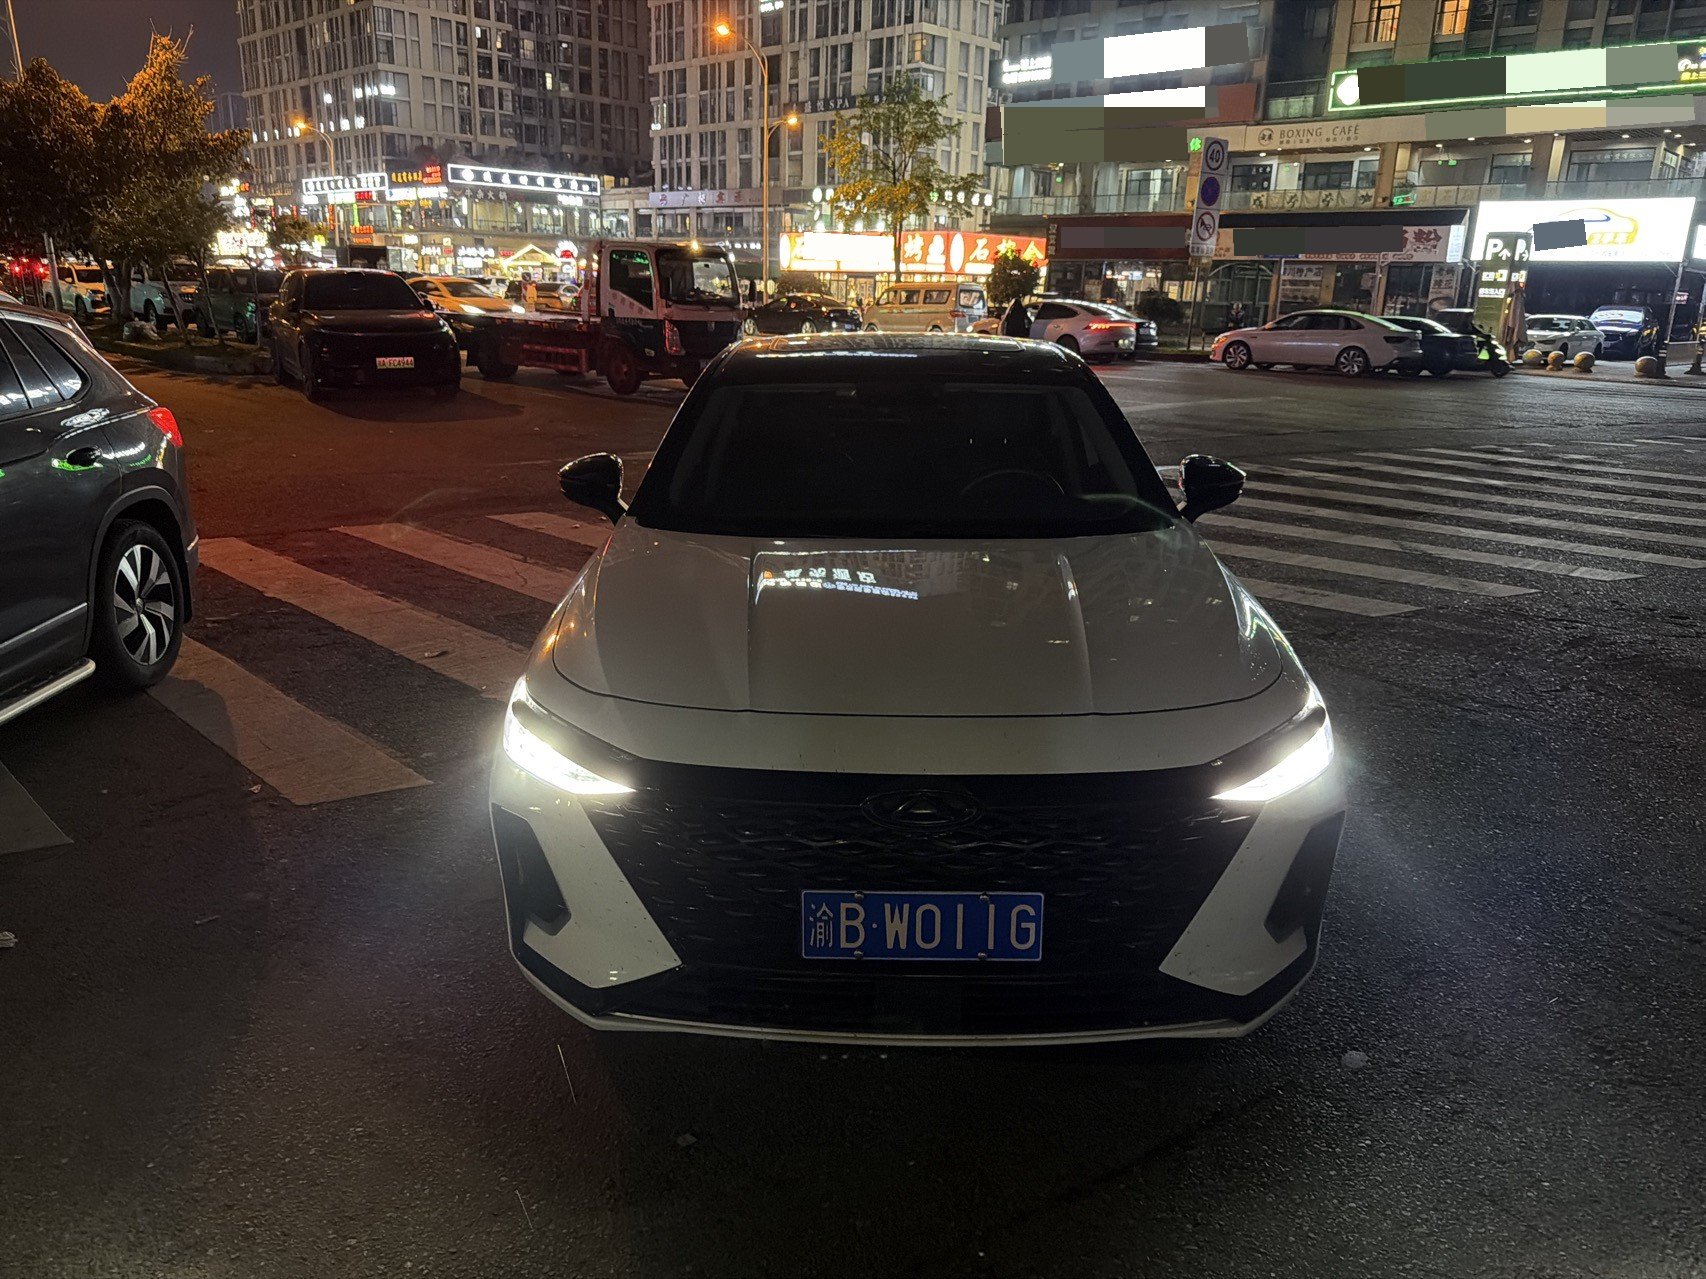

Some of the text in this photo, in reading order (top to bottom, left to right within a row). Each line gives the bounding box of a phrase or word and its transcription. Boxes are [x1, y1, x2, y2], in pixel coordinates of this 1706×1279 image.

[1279, 127, 1322, 139] BOXING
[1332, 123, 1360, 136] CAFÉ
[1209, 149, 1220, 163] 40
[1485, 238, 1504, 261] P
[1514, 238, 1526, 261] P
